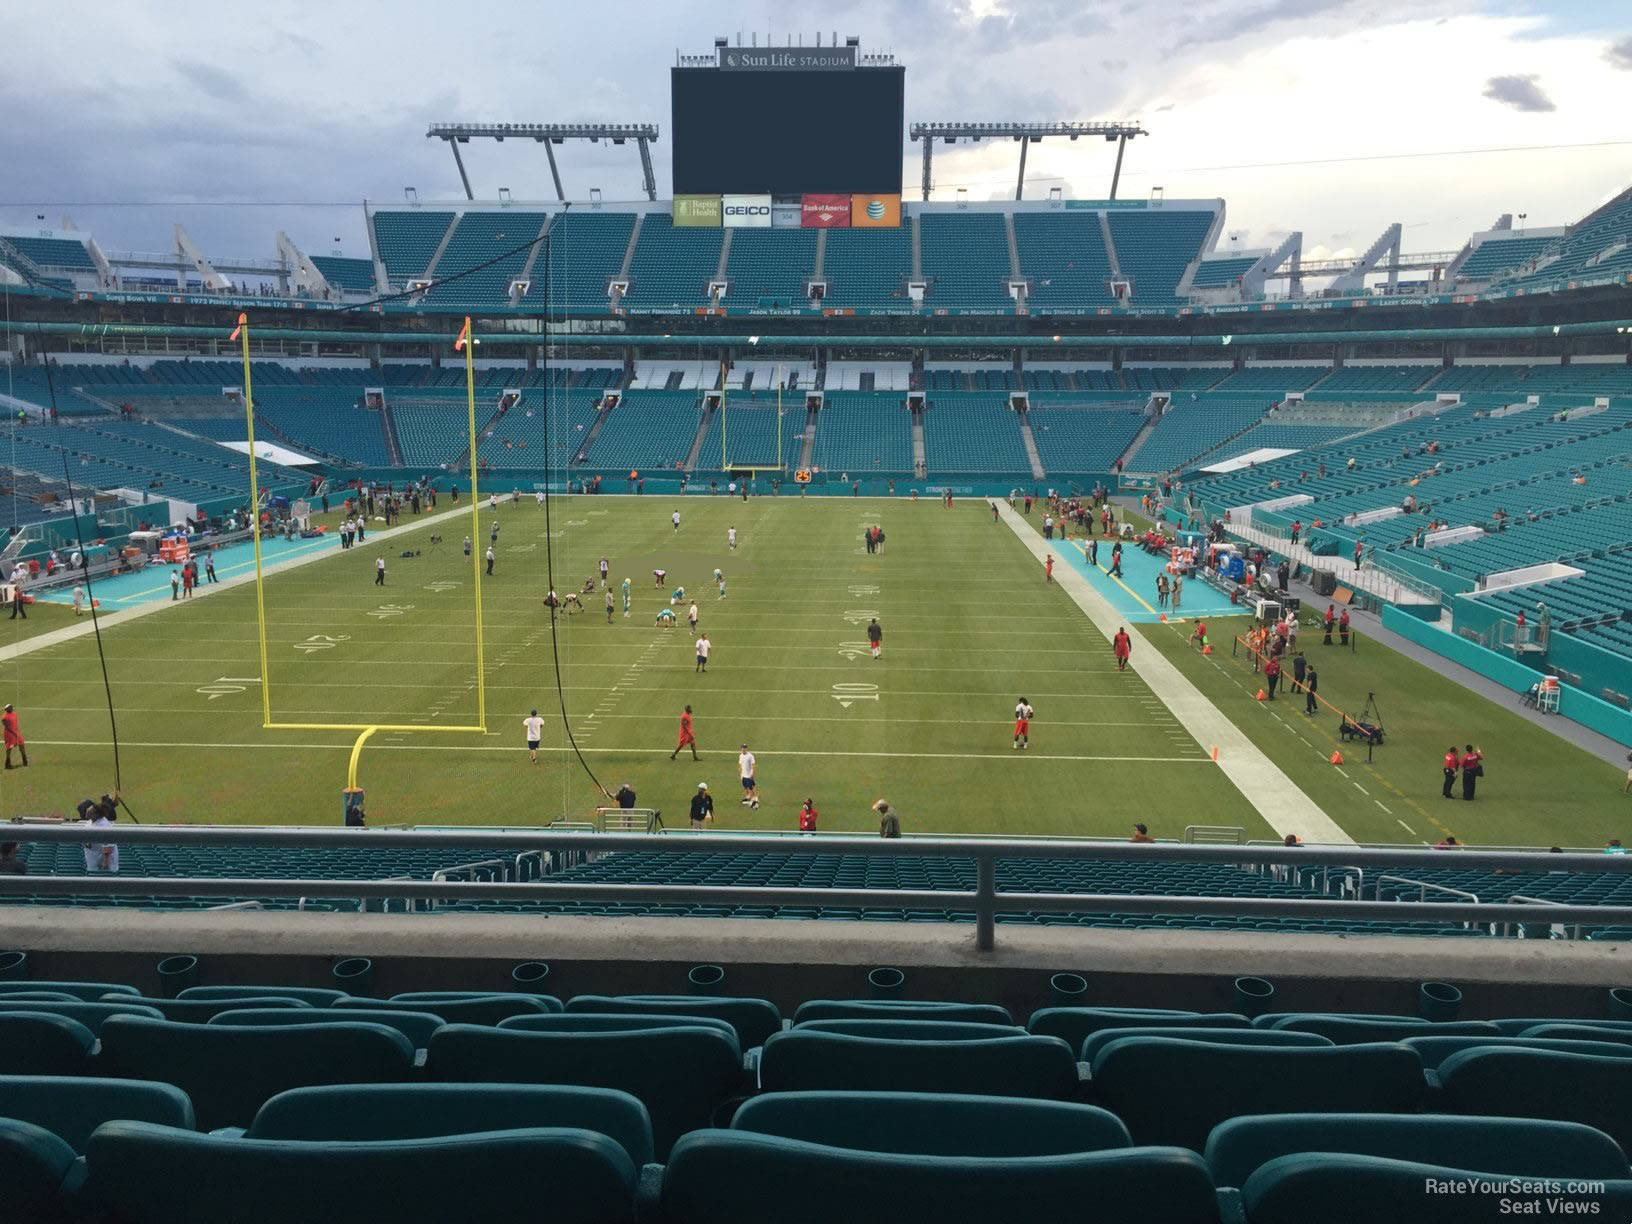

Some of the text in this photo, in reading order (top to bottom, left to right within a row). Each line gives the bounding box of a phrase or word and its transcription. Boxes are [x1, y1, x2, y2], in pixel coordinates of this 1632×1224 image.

[742, 53, 849, 66] Sun Life STADIUM
[693, 208, 717, 217] Health
[725, 207, 770, 215] GEICO
